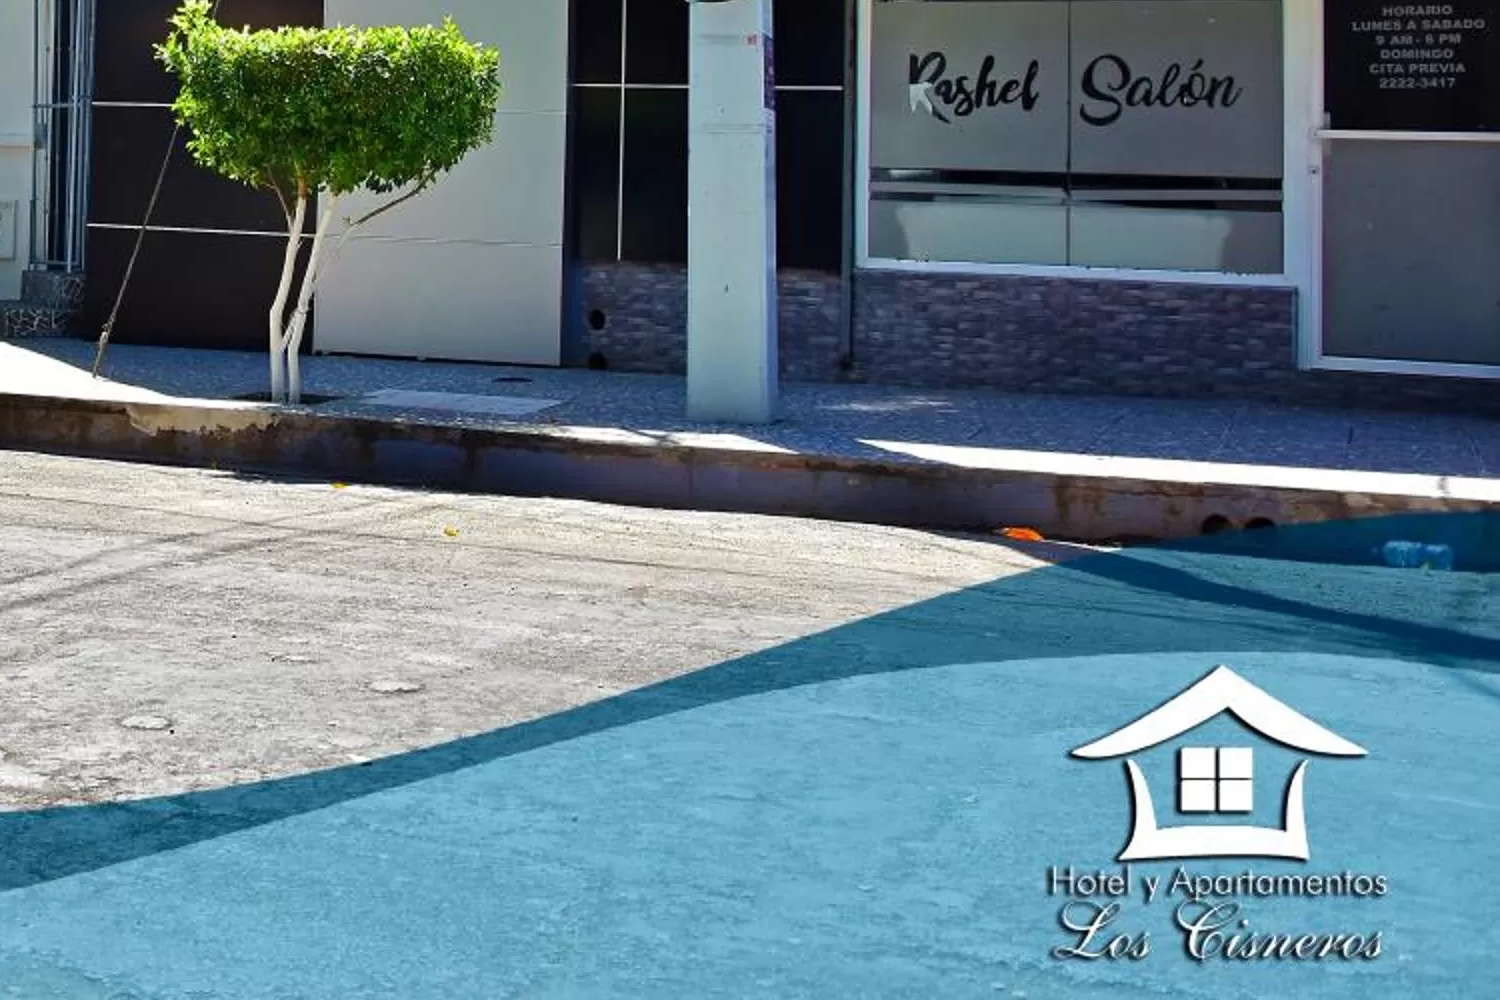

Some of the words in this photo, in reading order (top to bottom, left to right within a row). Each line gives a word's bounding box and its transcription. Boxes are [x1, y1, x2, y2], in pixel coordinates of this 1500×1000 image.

[1382, 4, 1453, 17] HORARIO
[1351, 20, 1401, 31] LUNES
[1406, 20, 1417, 30] A
[1375, 35, 1385, 45] 9
[1389, 35, 1413, 45] AM
[1439, 33, 1462, 45] PM
[1380, 48, 1454, 60] DOMINGO
[1369, 63, 1404, 73] CITA
[1409, 63, 1466, 73] PREVIA
[908, 51, 1040, 124] Rashel
[1079, 53, 1243, 126] Salón
[1379, 77, 1456, 88] 2222-3417
